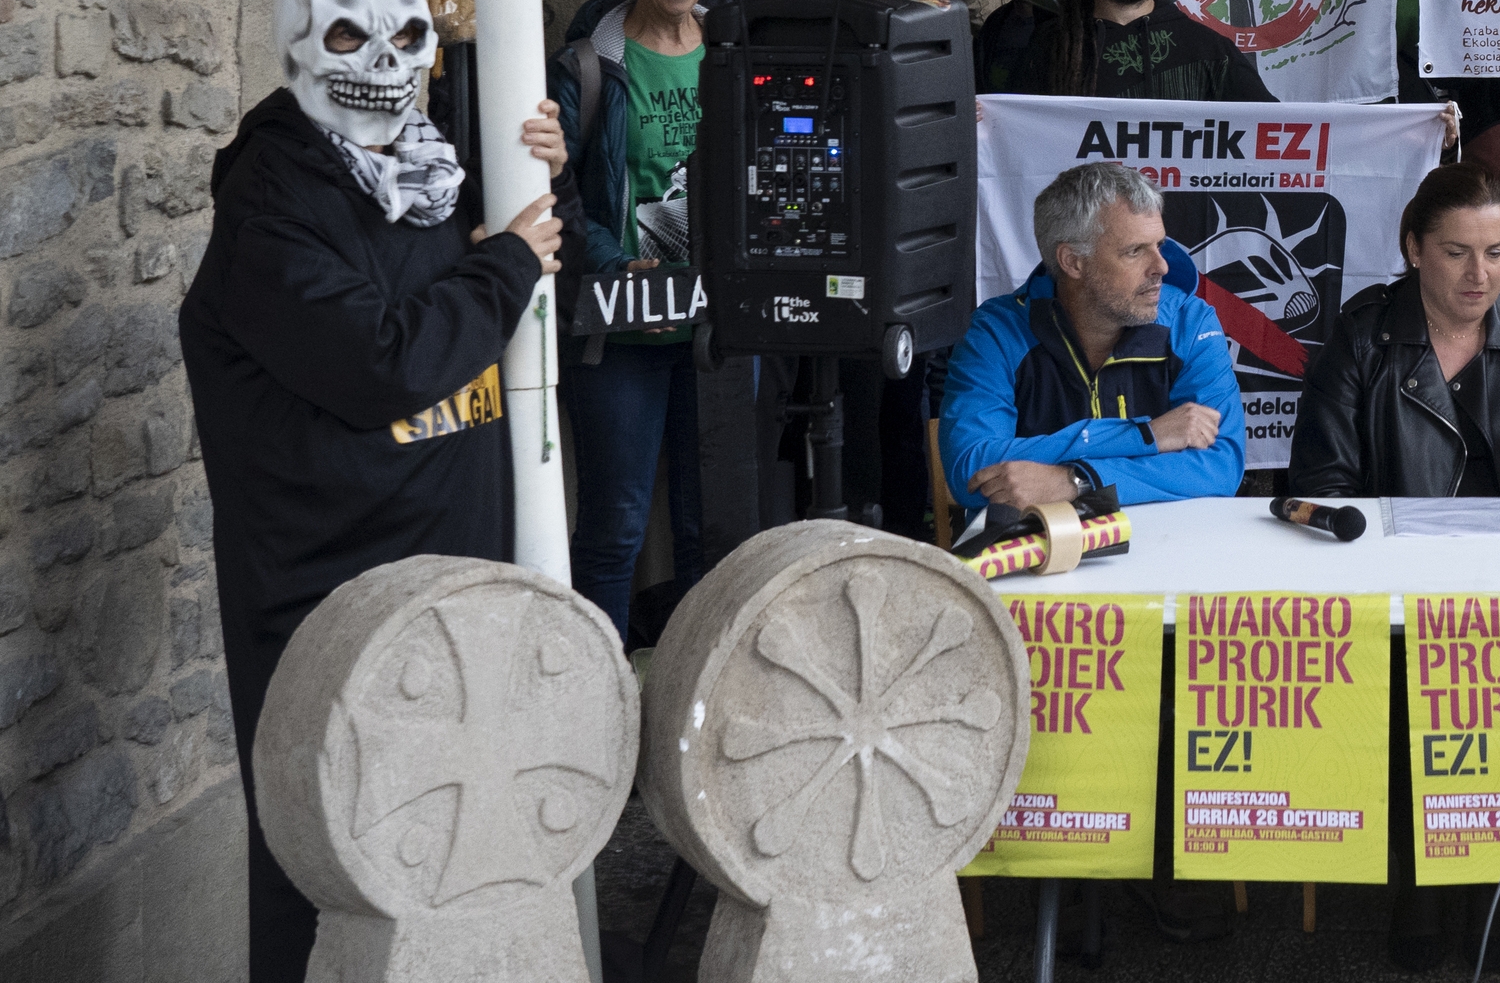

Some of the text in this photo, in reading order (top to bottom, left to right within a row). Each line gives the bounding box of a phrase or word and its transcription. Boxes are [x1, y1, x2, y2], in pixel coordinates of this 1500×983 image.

[1234, 32, 1257, 48] EZ
[649, 87, 699, 111] MAKR
[1076, 119, 1246, 159] AHTrik
[1189, 172, 1274, 188] sozialari
[789, 296, 811, 307] the
[1188, 595, 1353, 638] MAKRO
[1188, 639, 1354, 684] PROIEK
[1188, 684, 1322, 729] TURIK
[1188, 730, 1252, 772] EZ!
[1423, 733, 1489, 776] EZ!
[1186, 791, 1287, 806] MANIFESTAZIOA
[1023, 811, 1045, 827] 26
[1050, 813, 1127, 830] OCTUBRE
[1187, 808, 1359, 829] URRIAK 26 OCTUBRE
[1426, 812, 1492, 830] URRIAK
[1186, 828, 1218, 839] PLAZA
[1426, 831, 1458, 843] PLAZA
[1188, 841, 1225, 852] 18:00 H
[1427, 845, 1465, 858] 18:00 H
